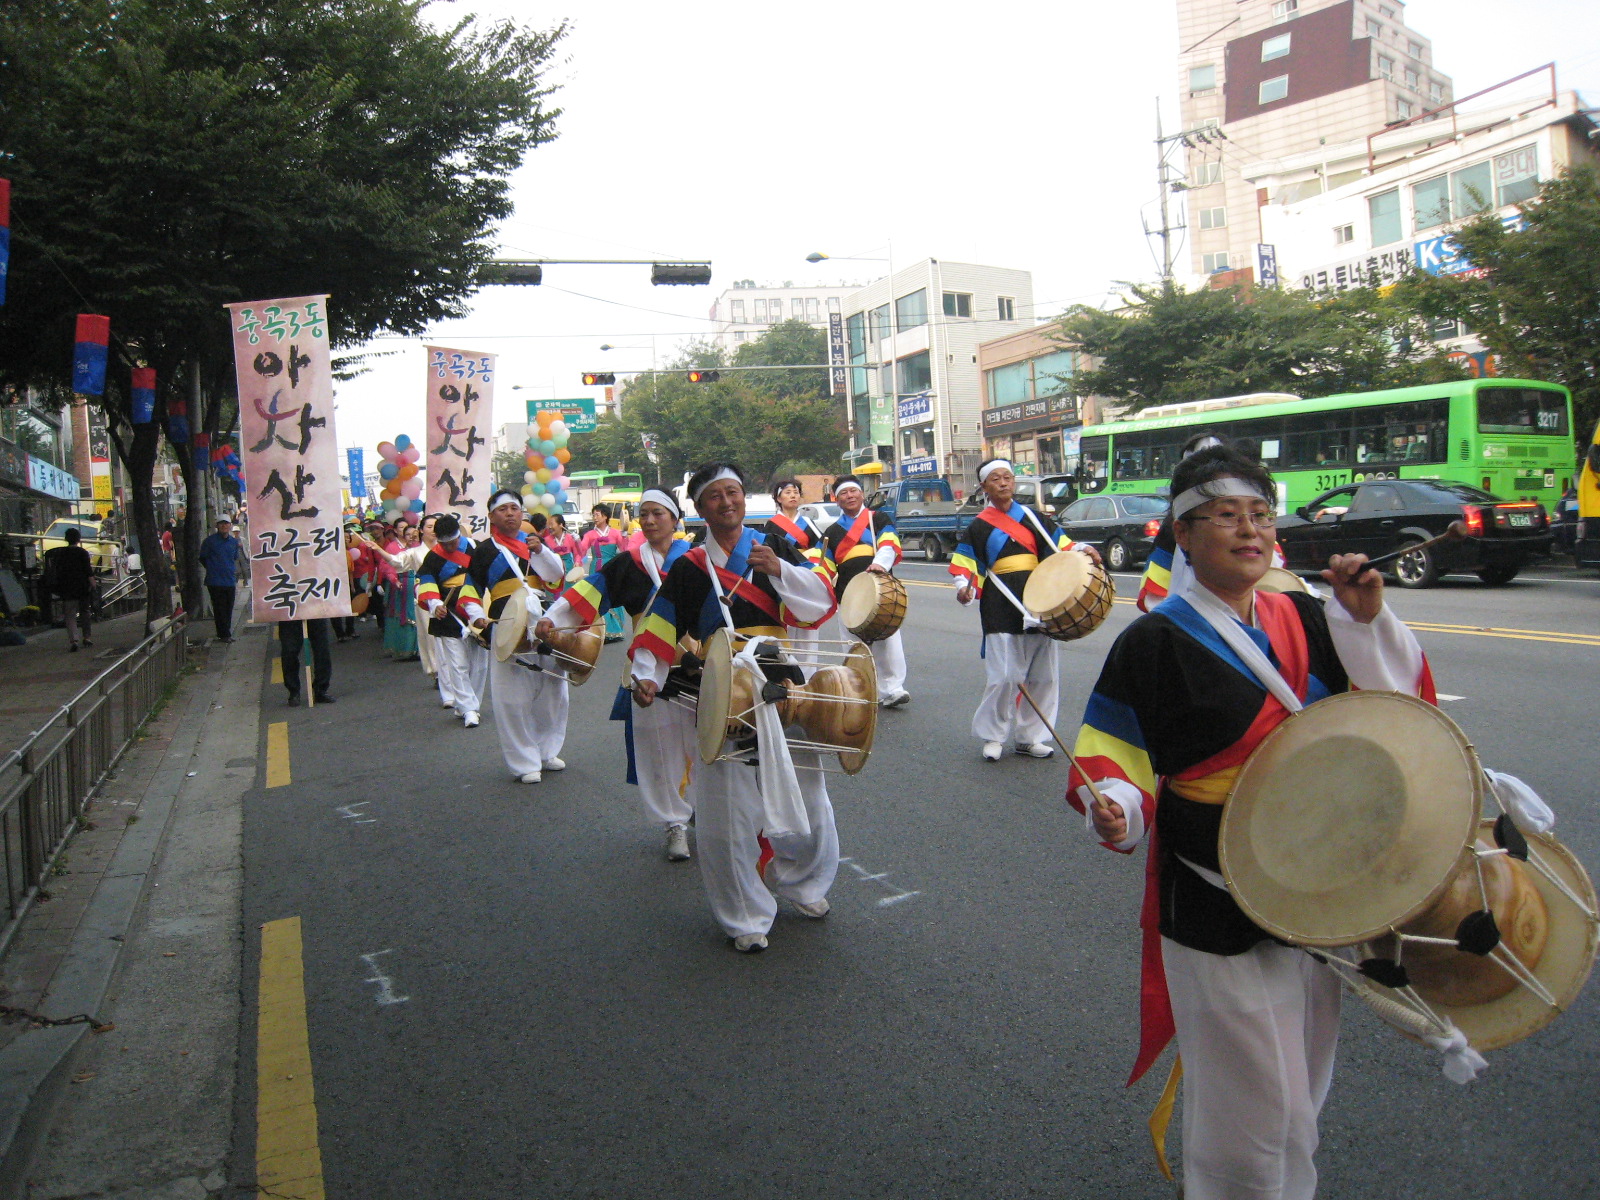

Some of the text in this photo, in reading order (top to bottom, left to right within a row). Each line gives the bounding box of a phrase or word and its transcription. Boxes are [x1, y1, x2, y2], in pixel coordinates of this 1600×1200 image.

[1497, 150, 1535, 180] 임대
[237, 302, 326, 344] 중곡3동
[430, 351, 493, 383] 중곡3동
[249, 344, 327, 521] 아차산
[1537, 411, 1560, 428] 3217
[430, 383, 486, 508] 아차산
[1315, 473, 1348, 492] 3217
[252, 526, 341, 566] 고구려
[263, 563, 341, 618] 축제
